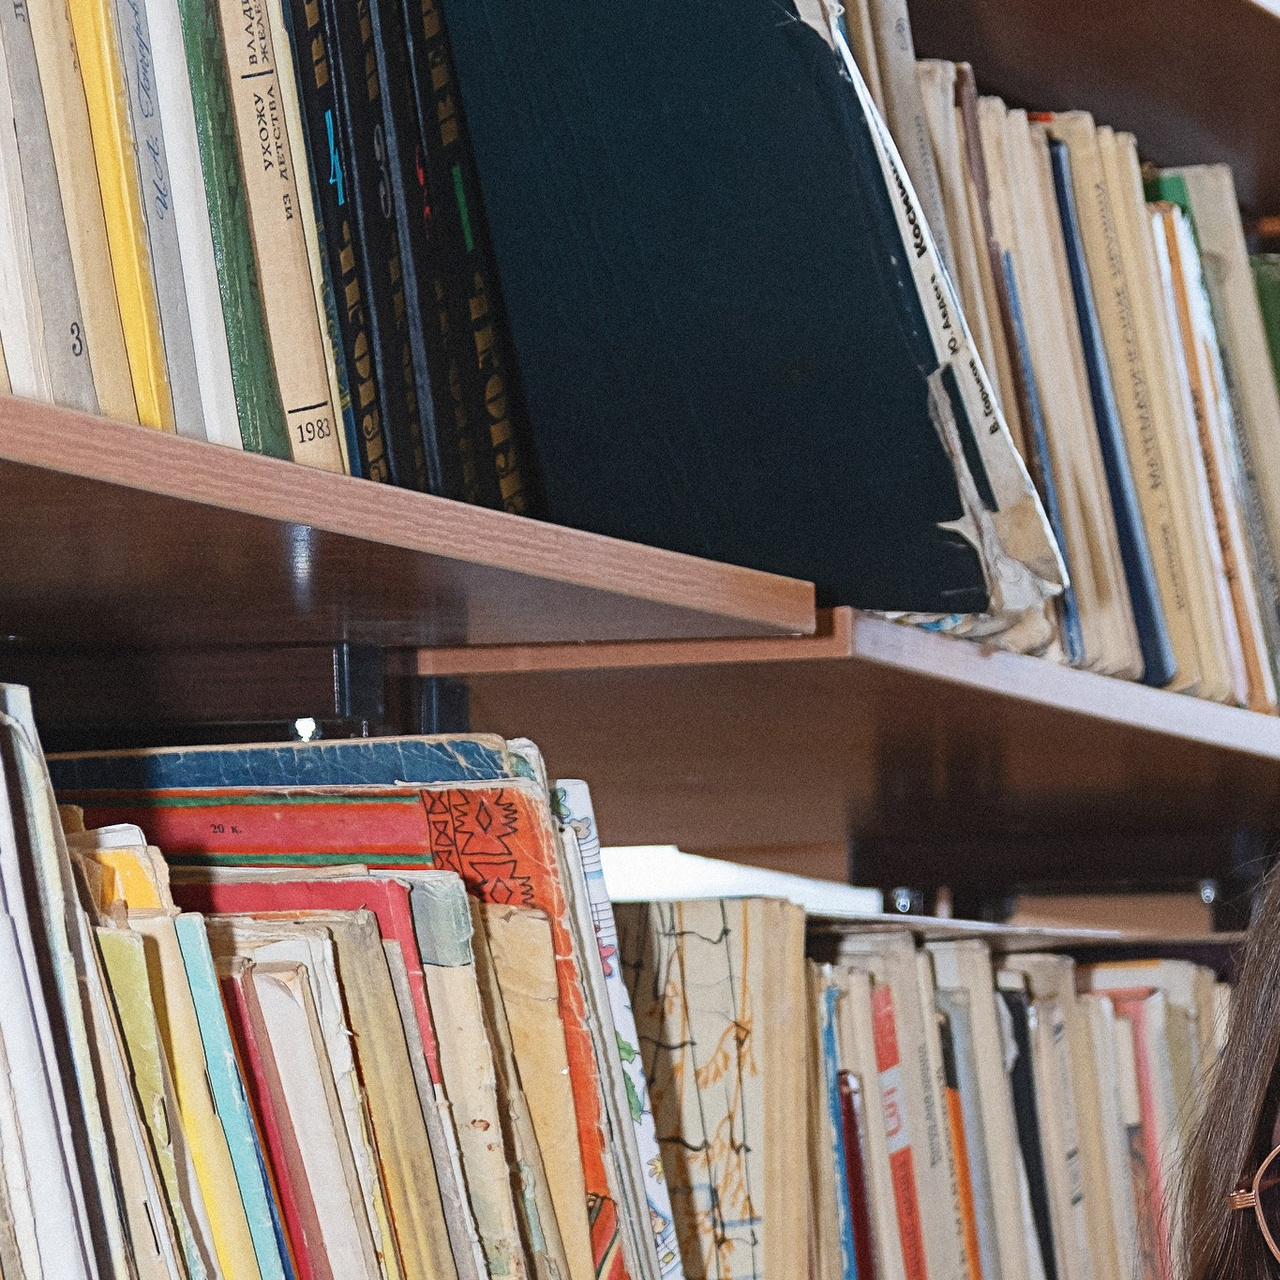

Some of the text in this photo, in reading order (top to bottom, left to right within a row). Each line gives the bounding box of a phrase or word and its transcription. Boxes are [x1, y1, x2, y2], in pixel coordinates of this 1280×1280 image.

[253, 92, 275, 172] УХОЖУ
[267, 86, 293, 220] ИЗ ДЕТСТВА
[296, 417, 333, 444] 1983
[210, 823, 225, 834] 20
